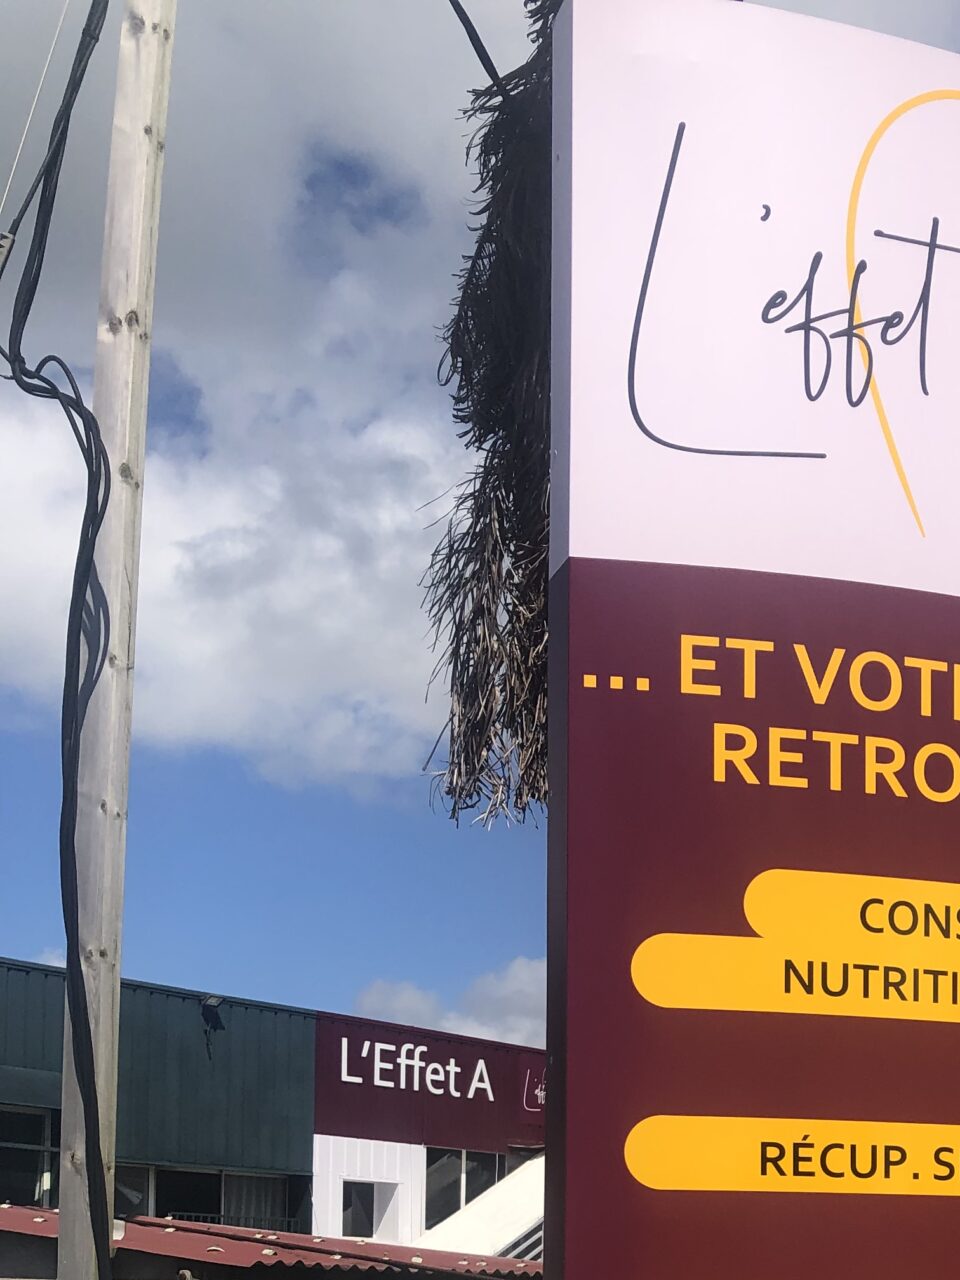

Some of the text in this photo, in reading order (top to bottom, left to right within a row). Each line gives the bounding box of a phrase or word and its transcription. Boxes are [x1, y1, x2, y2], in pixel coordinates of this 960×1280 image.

[680, 634, 775, 699] ET
[341, 1036, 495, 1102] L'Effet A
[760, 1134, 920, 1180] RÉCUP.
